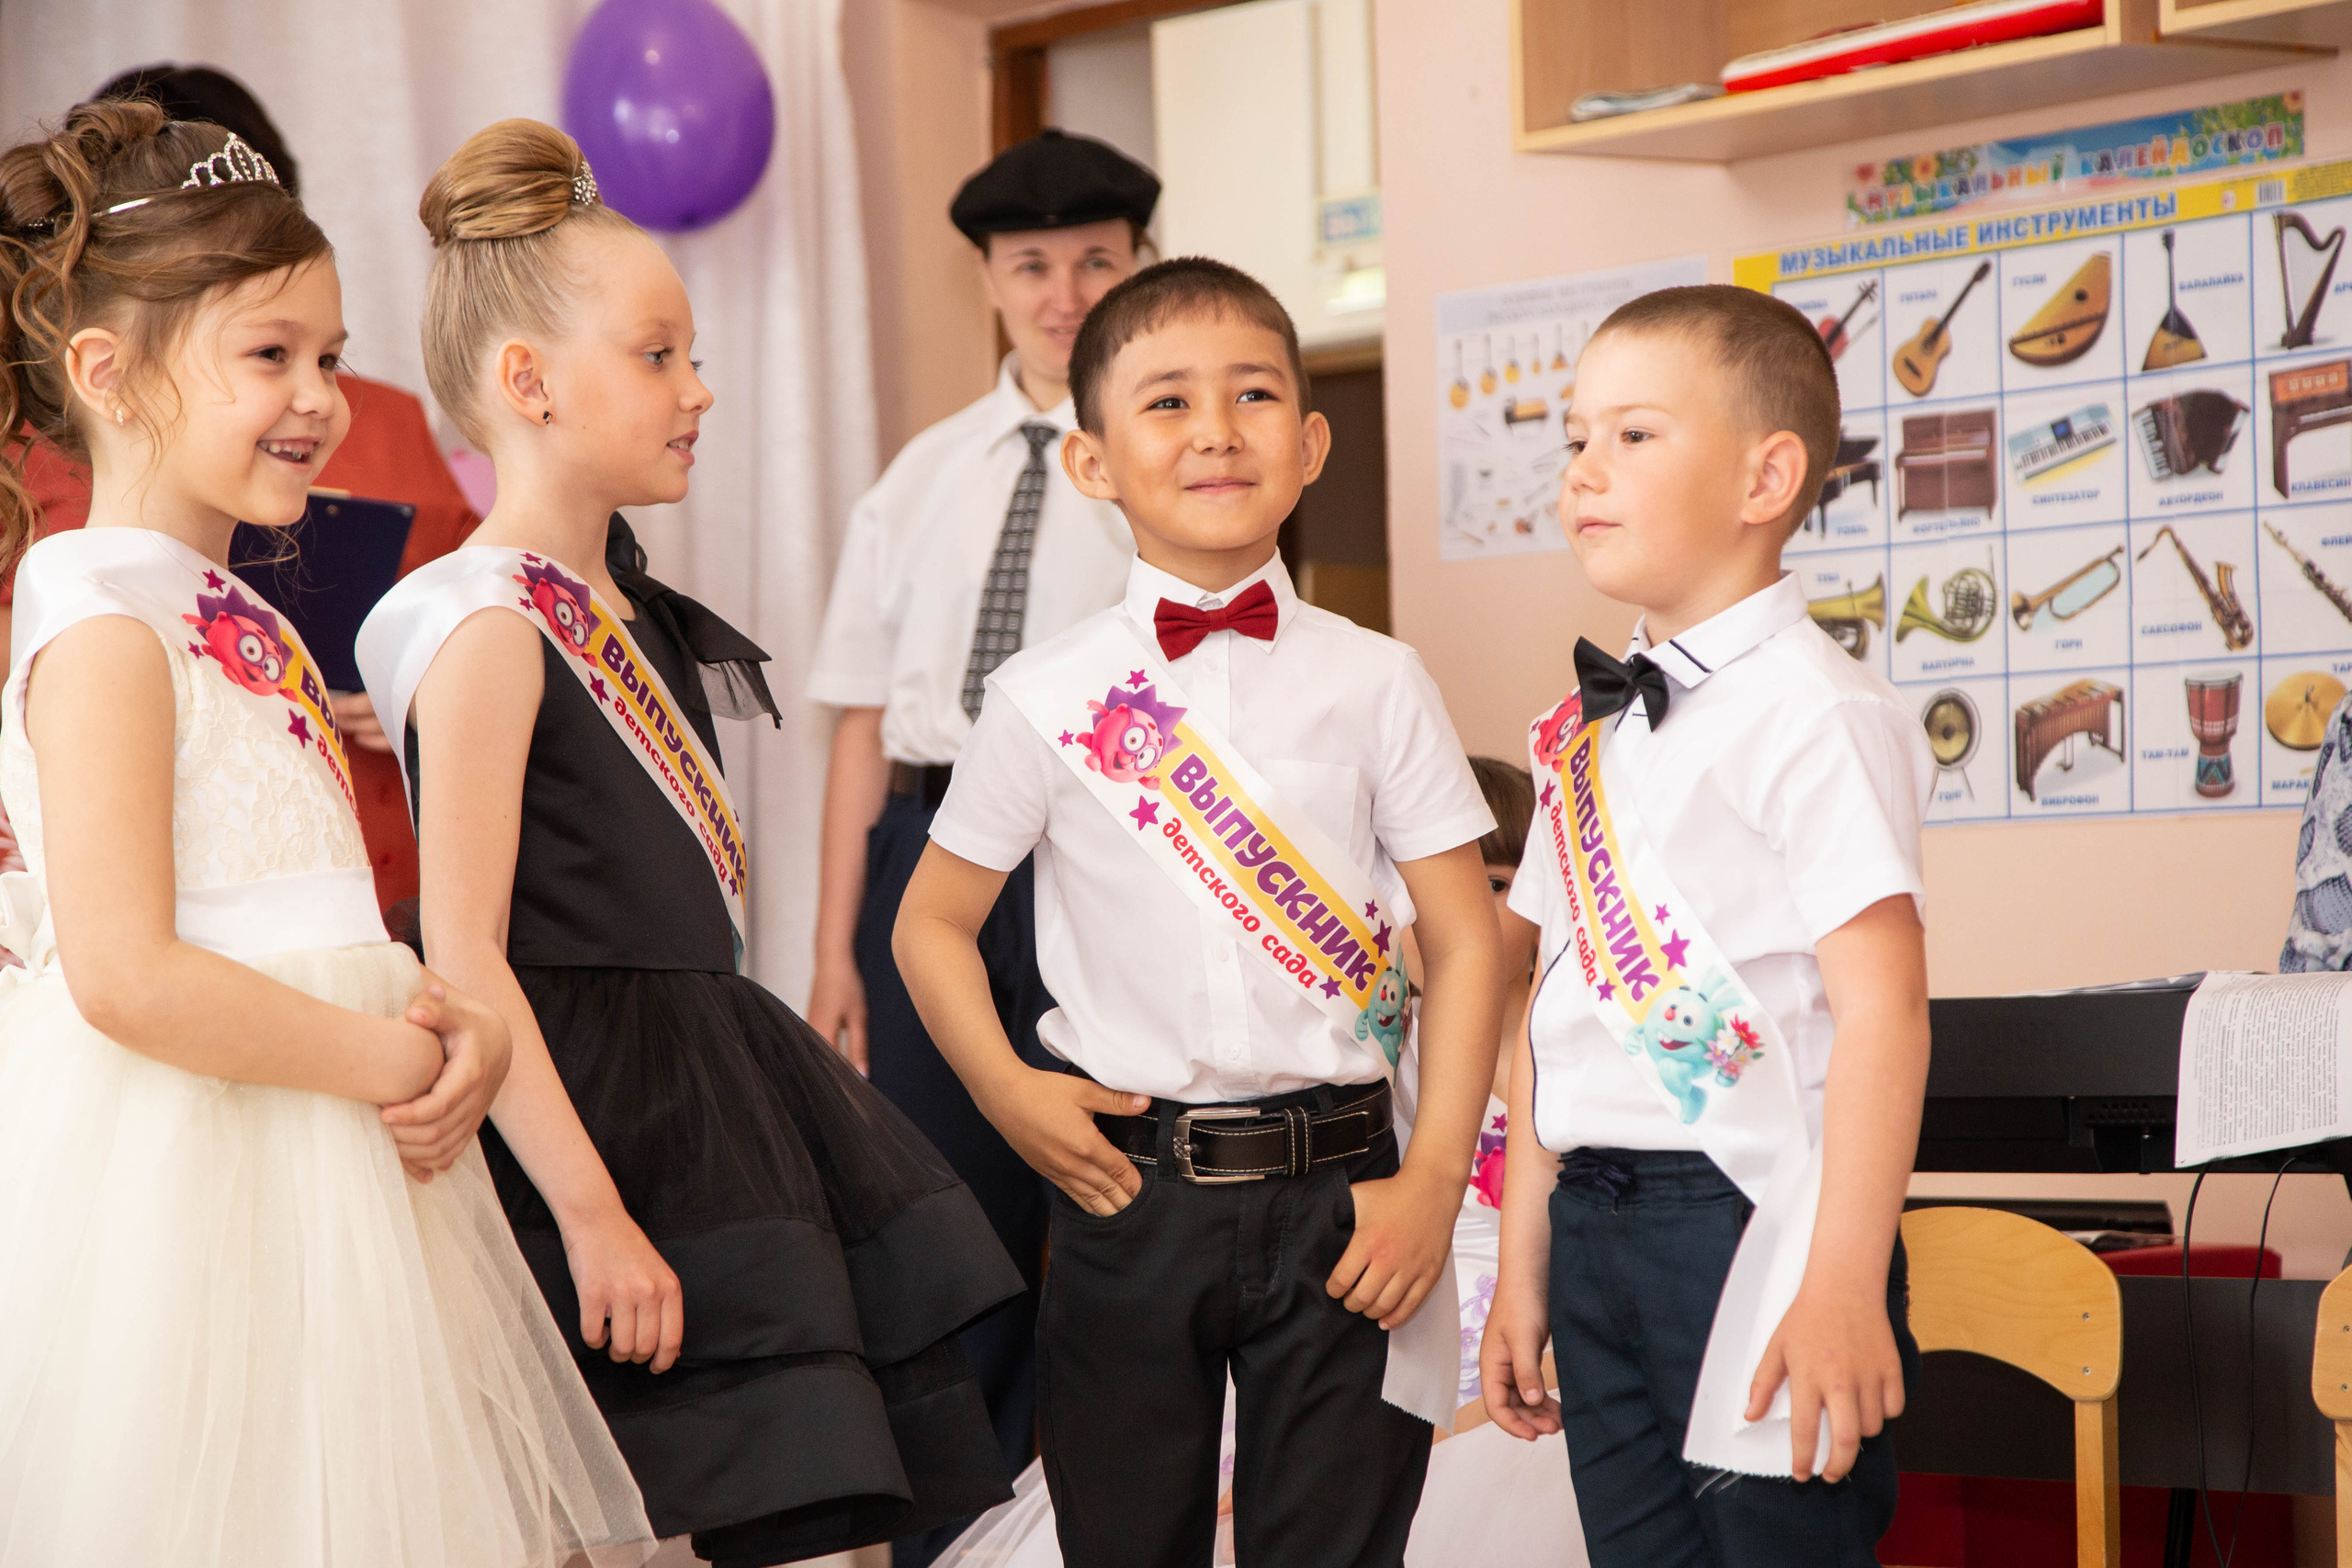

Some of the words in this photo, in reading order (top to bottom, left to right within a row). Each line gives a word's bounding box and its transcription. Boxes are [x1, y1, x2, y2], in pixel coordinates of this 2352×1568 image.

[2079, 121, 2286, 176] КАЛЕЙДОСКОП
[1781, 225, 1970, 274] МУЗЫКАЛЬНЫЕ
[1977, 192, 2177, 245] ИНСТРУМЕНТЫ
[2179, 273, 2245, 291] БАЛАЛАЙКА
[2291, 478, 2351, 491] КЛАВЕСИН
[2031, 489, 2100, 504] СИНТЕЗАТОР
[2159, 491, 2223, 506] АККОРДЕОН
[2142, 621, 2202, 635] САКСОФОН
[2054, 638, 2083, 649] ГОРН
[1922, 657, 1974, 671] ВАЛТОРНА
[2142, 748, 2189, 760] ТАМ-ТАМ
[601, 633, 746, 896] ВЫПУСКНИК
[615, 695, 695, 818] детского
[698, 821, 728, 883] сада
[2041, 795, 2099, 807] ВИБРОФОН
[1170, 752, 1377, 992] ВЫПУСКНИК
[1570, 736, 1661, 1002] ВЫПУСКНИК
[1550, 800, 1580, 921] детского
[1577, 926, 1598, 987] сада
[1162, 817, 1261, 932] детского
[1261, 934, 1317, 989] сада
